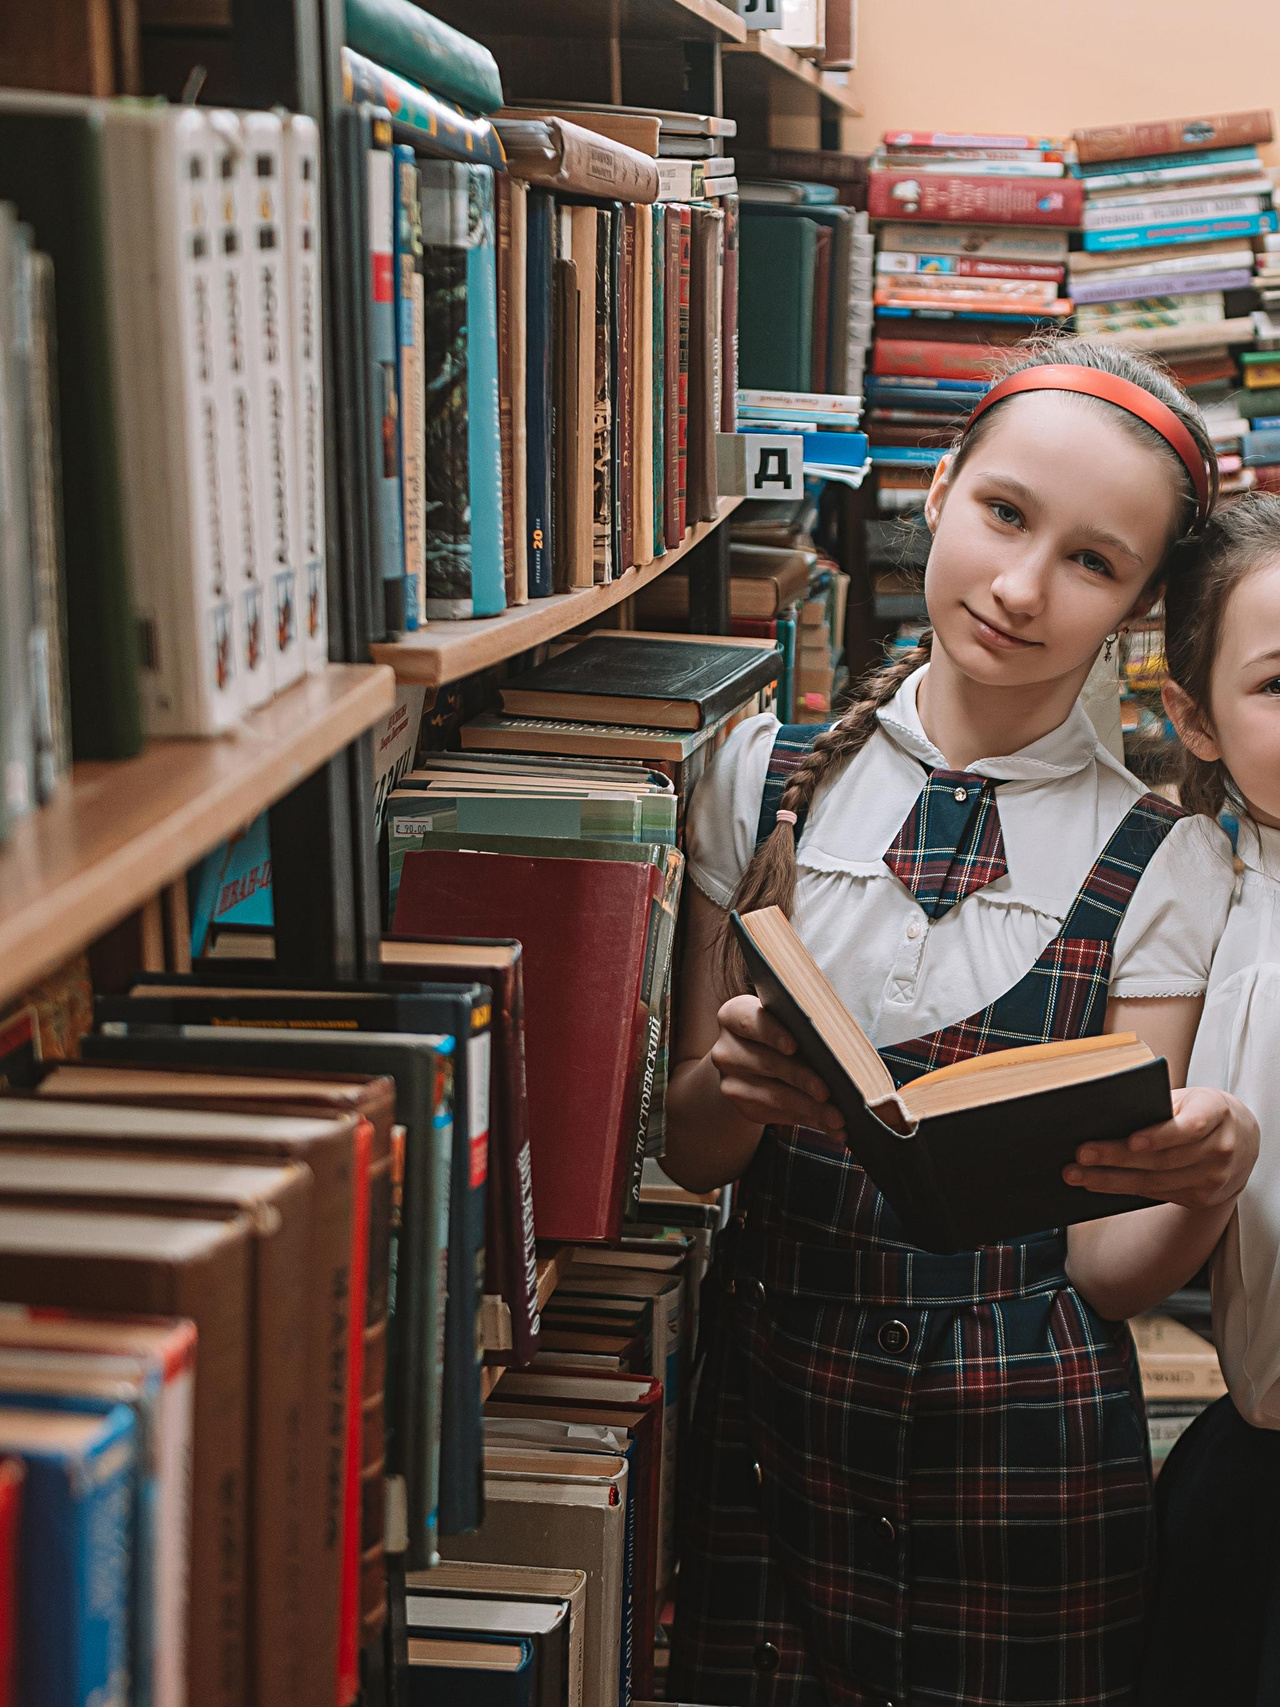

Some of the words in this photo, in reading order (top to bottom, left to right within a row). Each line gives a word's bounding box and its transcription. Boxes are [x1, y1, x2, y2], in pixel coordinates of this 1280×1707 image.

[754, 448, 792, 489] Д
[533, 529, 543, 549] 20
[404, 823, 427, 835] 90.00
[636, 1014, 661, 1155] ДОСТОЕВСКИЙ
